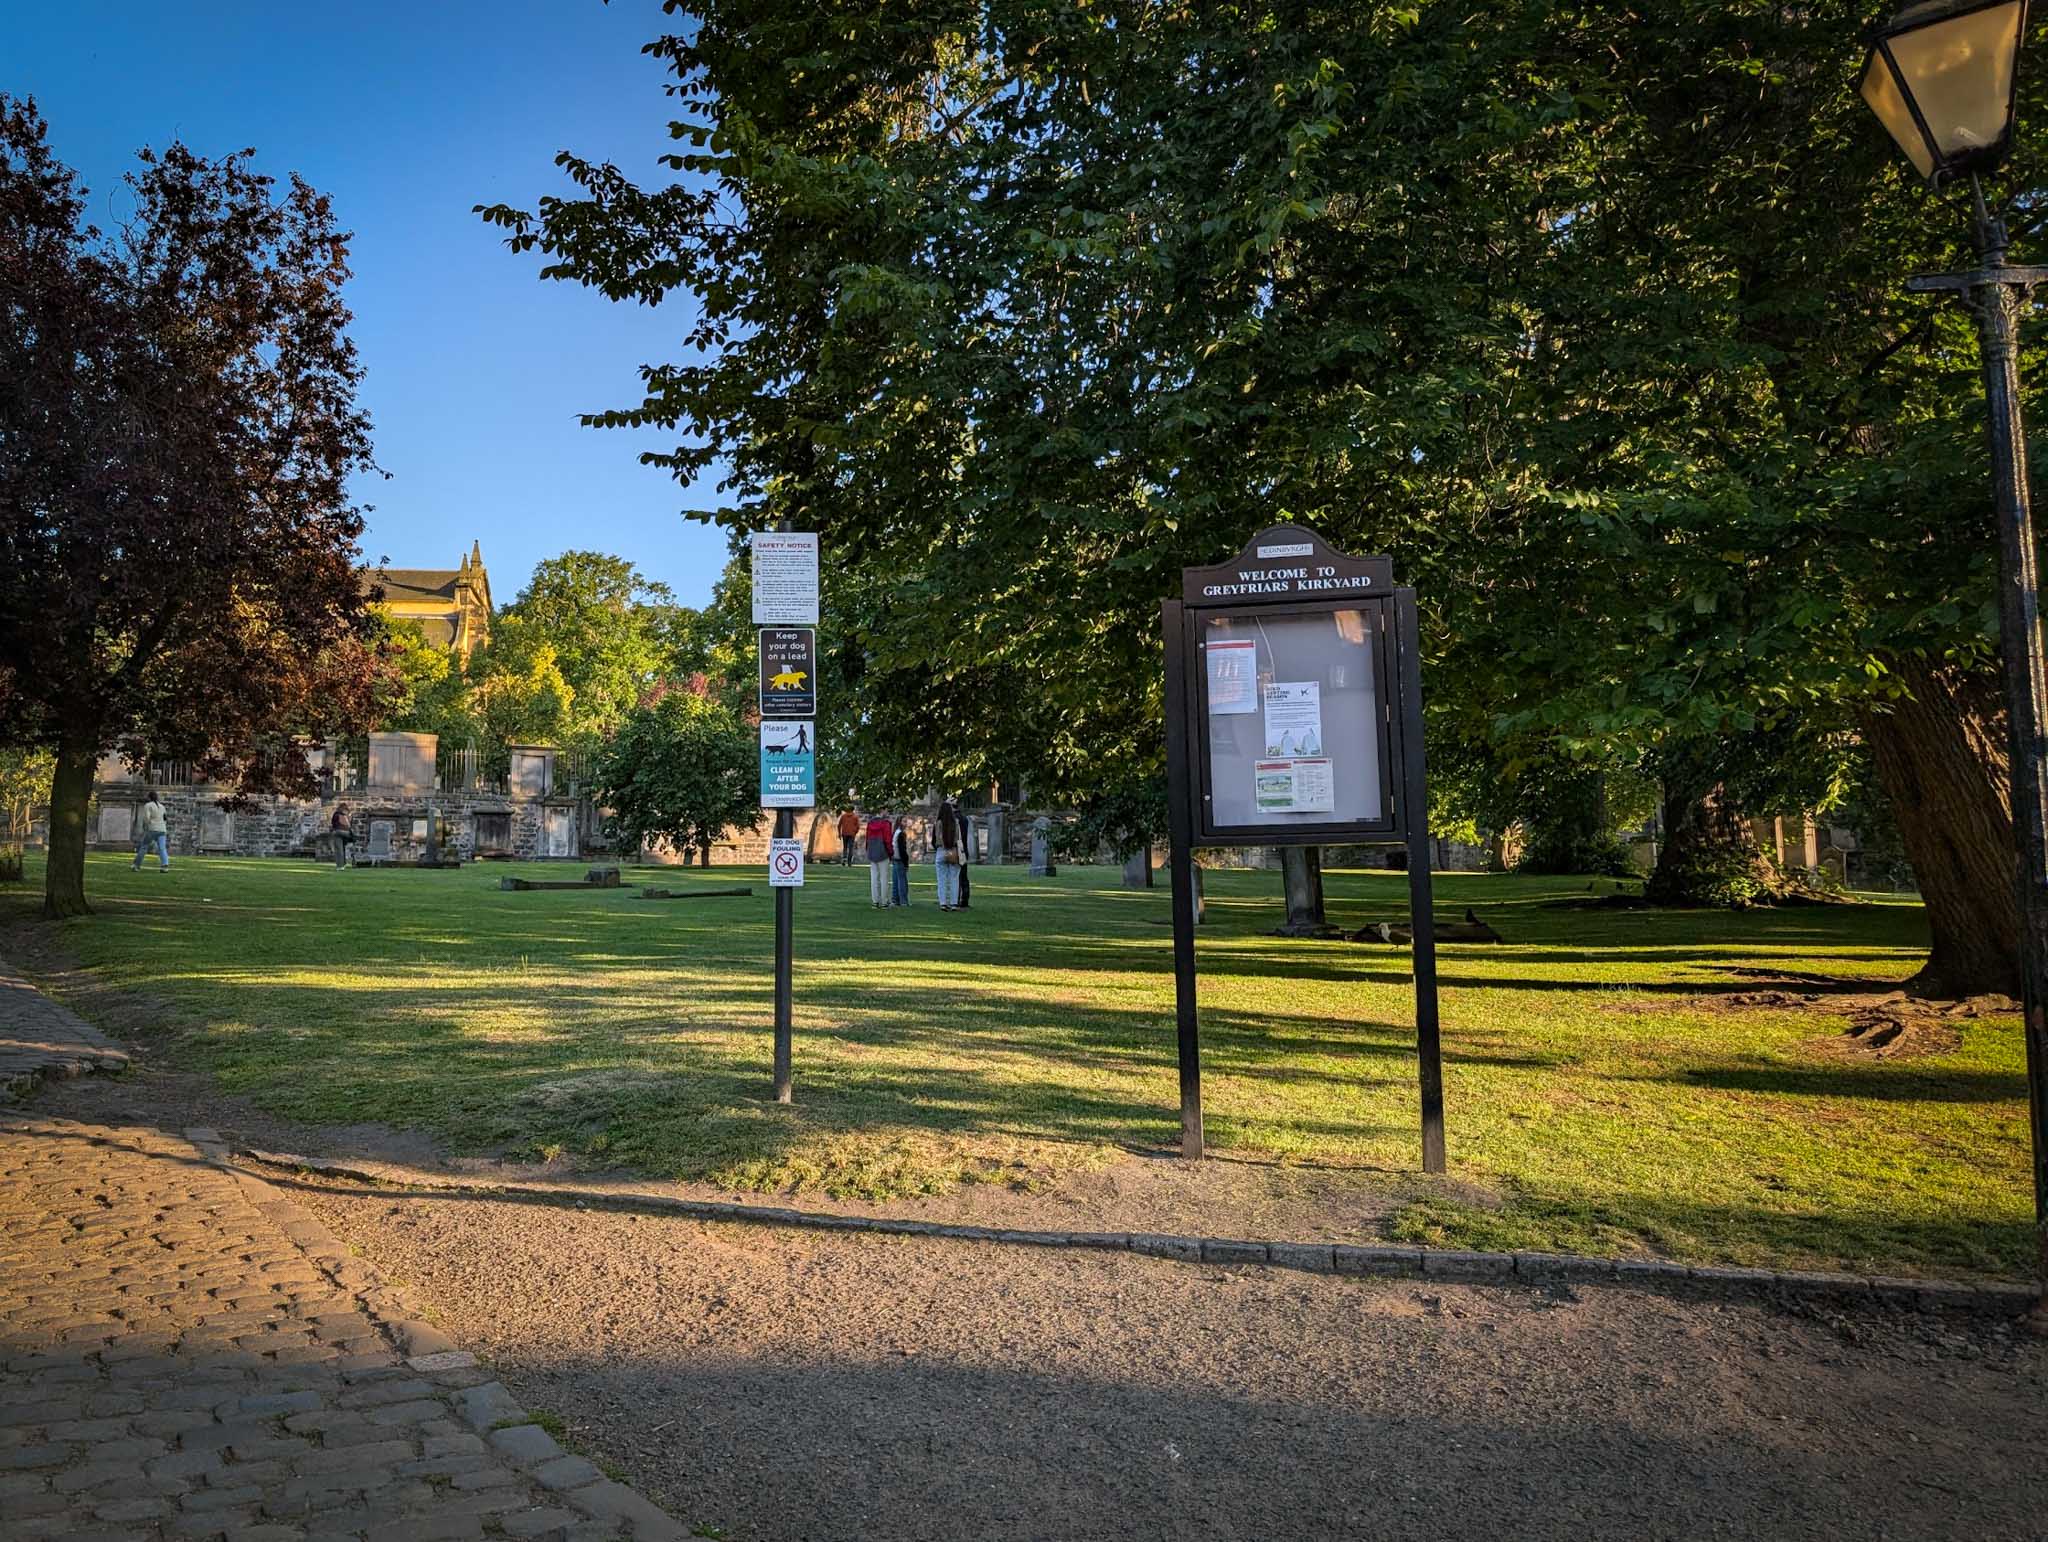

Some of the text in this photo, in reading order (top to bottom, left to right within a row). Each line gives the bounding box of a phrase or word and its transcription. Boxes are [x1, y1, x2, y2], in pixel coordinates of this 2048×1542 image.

[1238, 566, 1335, 581] WELCOME TO
[1203, 576, 1371, 596] GREYFRIARS KIRKYARD
[775, 631, 798, 640] Keep
[768, 642, 806, 651] your dog
[788, 652, 807, 660] lead
[763, 724, 788, 732] Please
[770, 766, 806, 774] CLEAN UP
[768, 783, 807, 791] YOUR DOG
